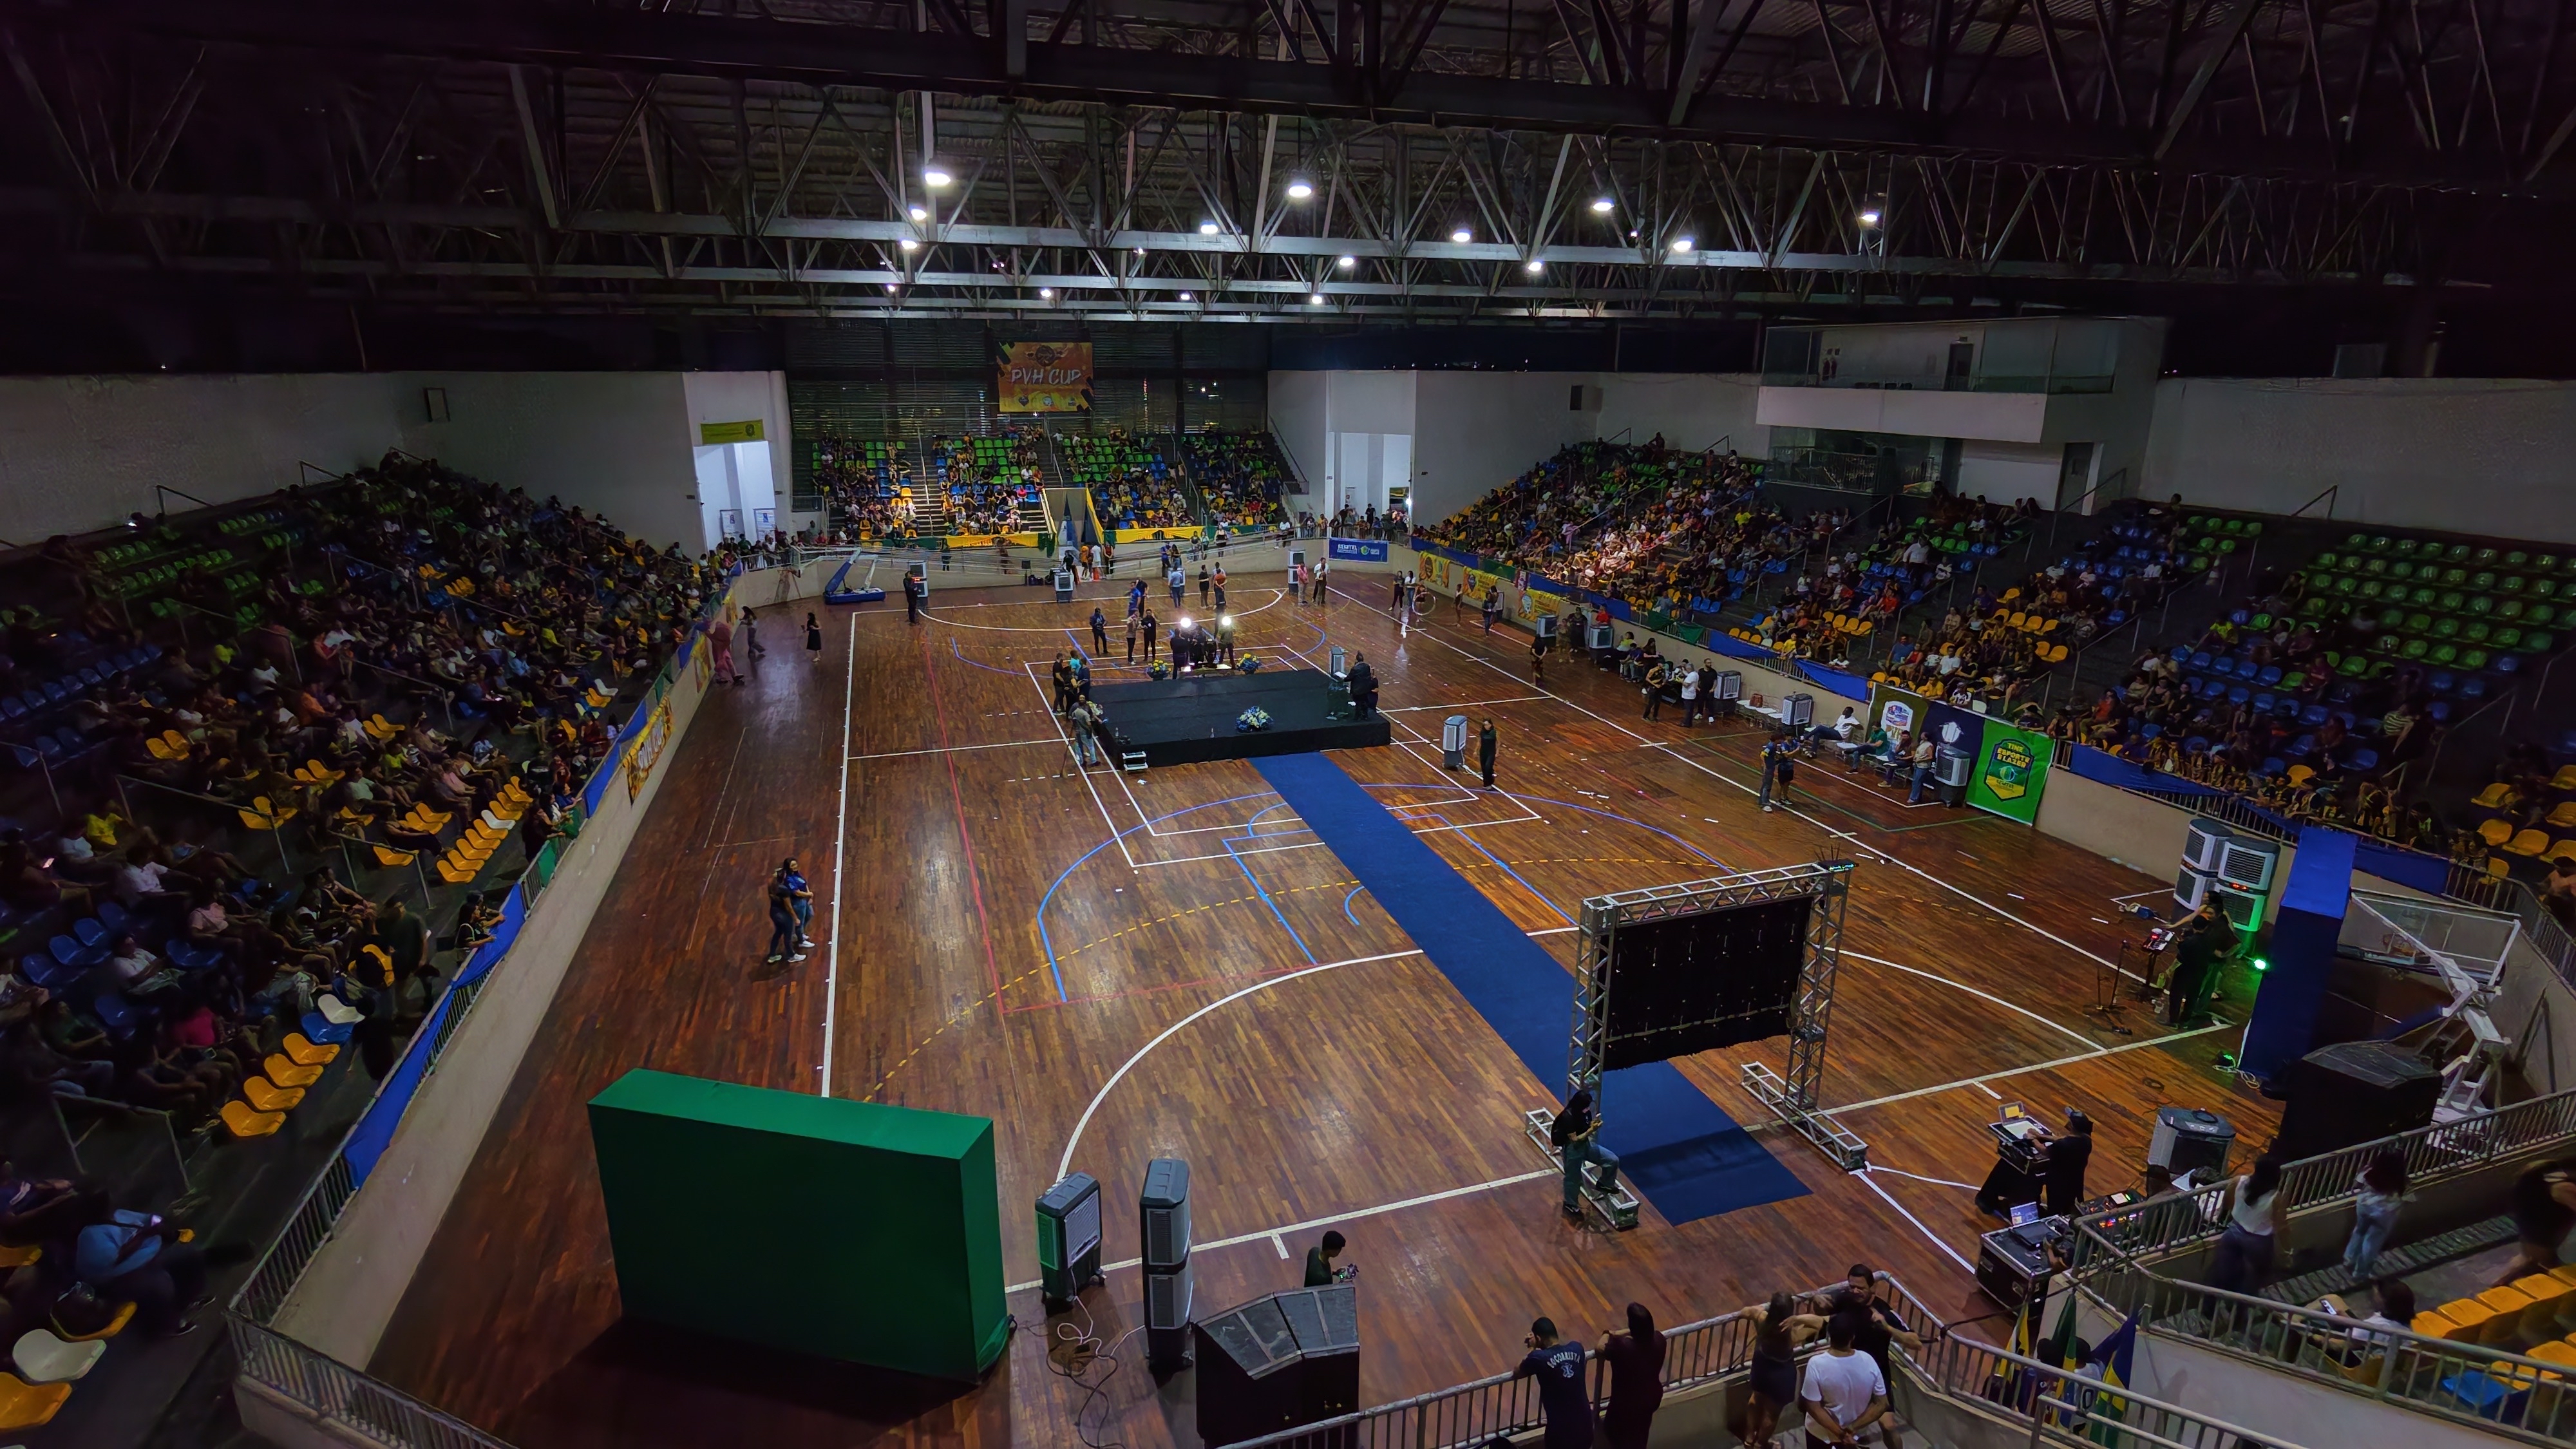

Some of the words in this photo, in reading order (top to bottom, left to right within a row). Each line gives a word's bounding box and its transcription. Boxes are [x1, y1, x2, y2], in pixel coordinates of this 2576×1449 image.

[1010, 368, 1044, 385] PVH
[1048, 368, 1082, 385] CUP
[1997, 748, 2031, 763] ESPORTE
